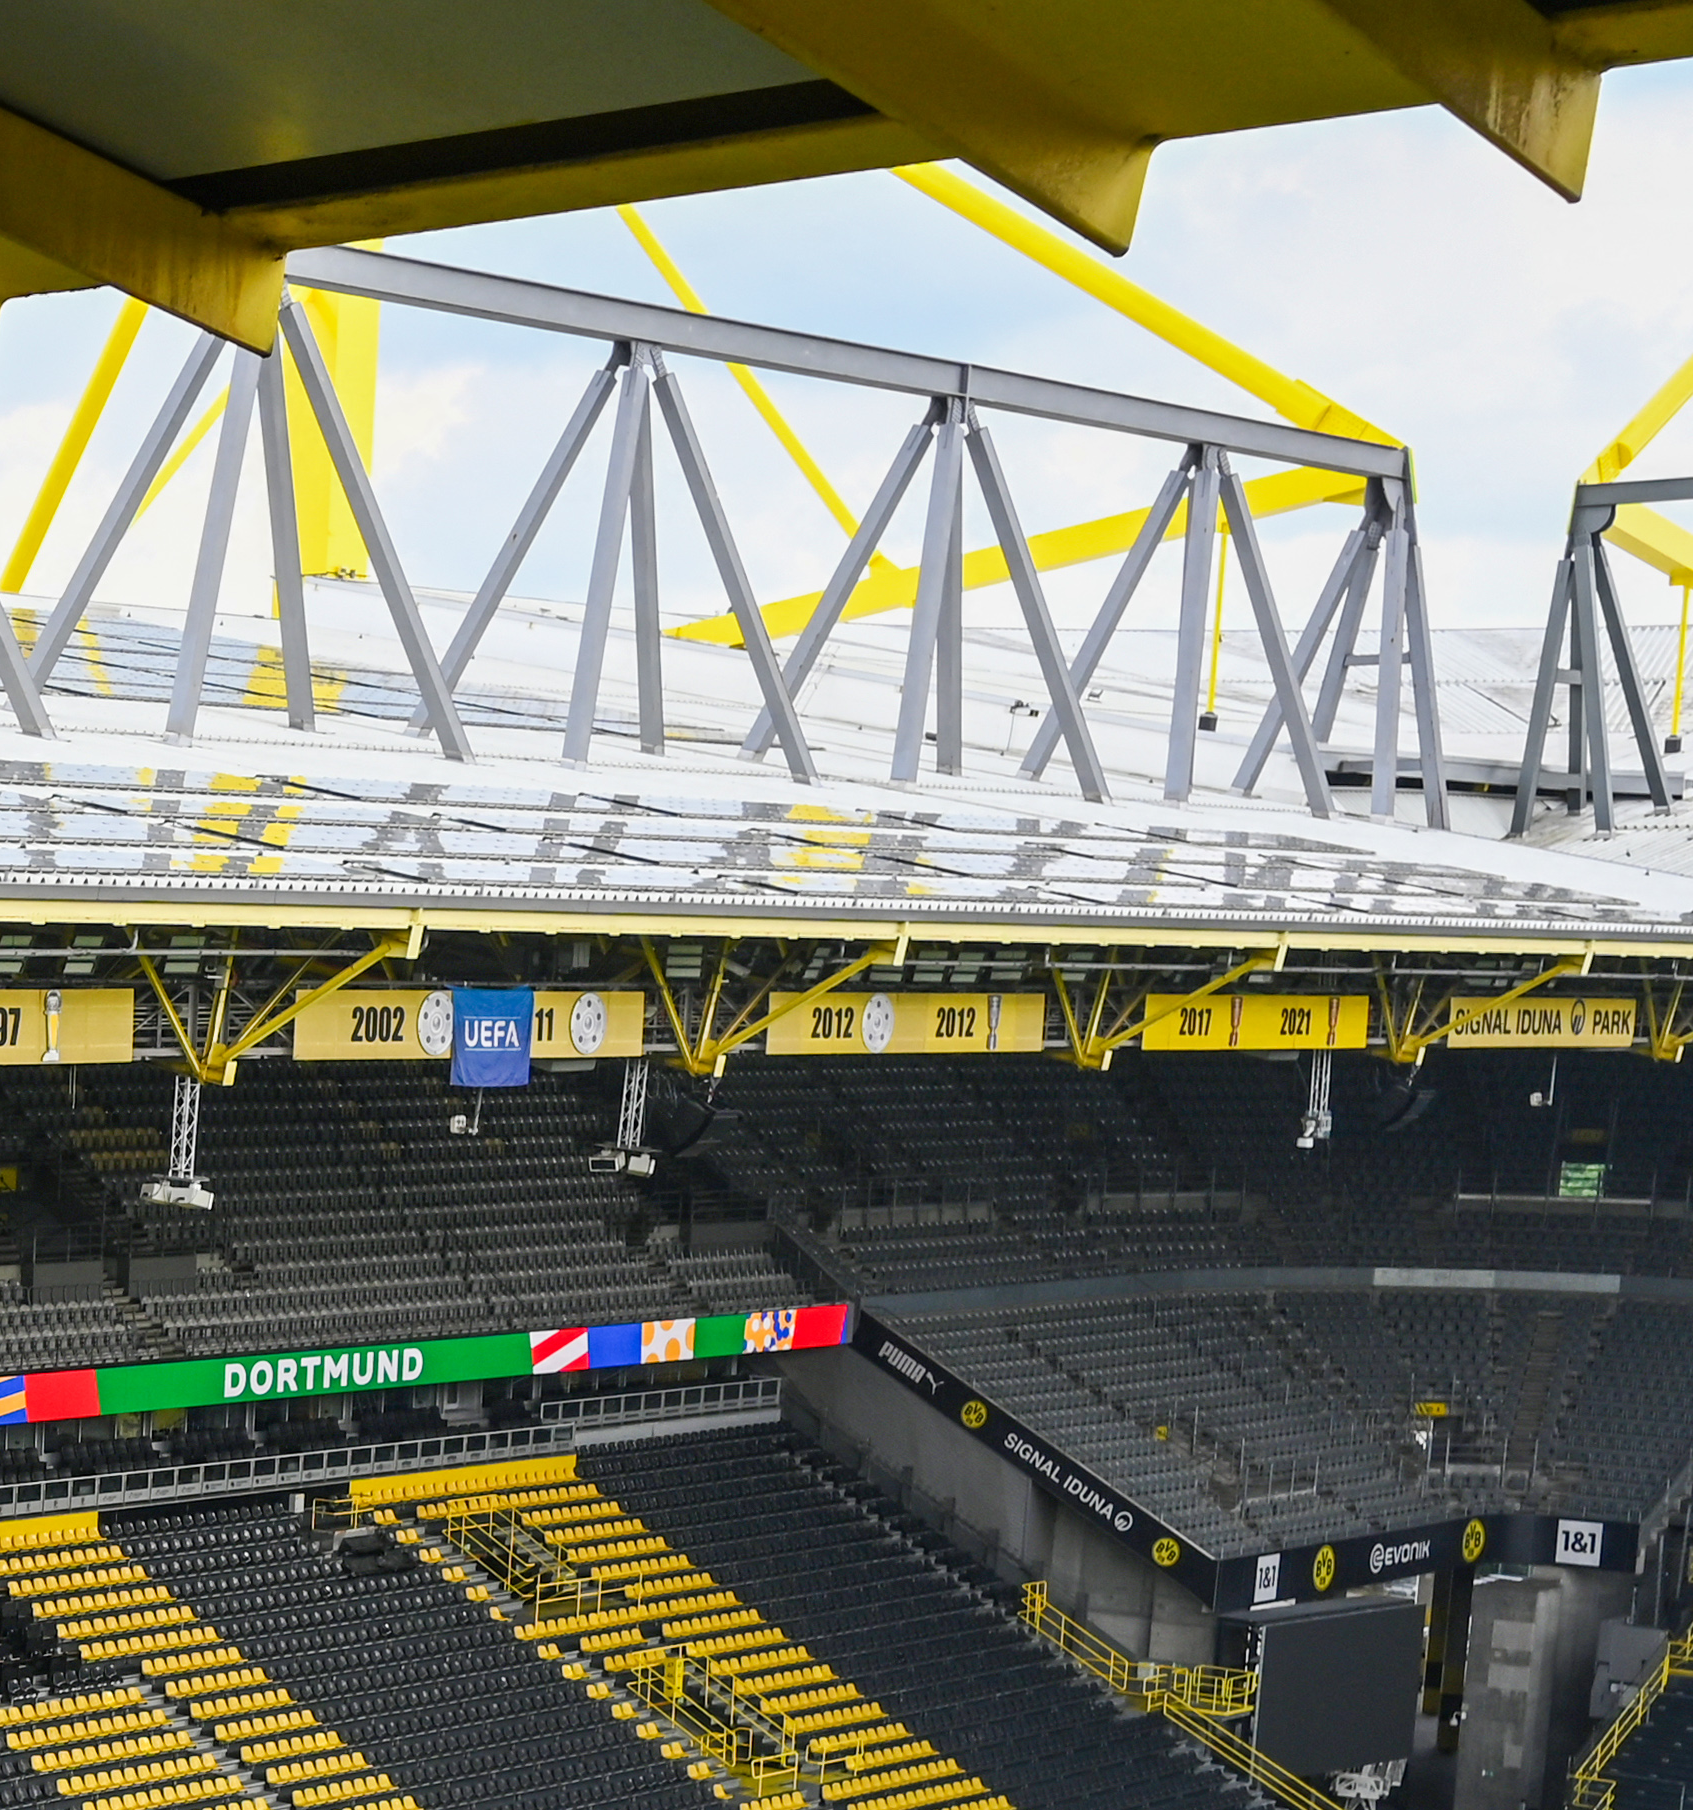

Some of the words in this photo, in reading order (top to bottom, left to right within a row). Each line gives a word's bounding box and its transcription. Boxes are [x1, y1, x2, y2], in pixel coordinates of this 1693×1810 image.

[351, 1006, 405, 1043] 2002
[465, 1020, 520, 1047] UEFA
[811, 1007, 854, 1038] 2012
[936, 1007, 975, 1038] 2012
[1179, 1008, 1212, 1036] 2017
[1280, 1008, 1311, 1035] 2021
[1454, 1008, 1511, 1035] SIGNAL
[1516, 1009, 1562, 1035] IDUNA
[1592, 1010, 1631, 1035] PARK
[224, 1348, 423, 1397] DORTMUND
[878, 1341, 927, 1384] PUMA
[964, 1403, 985, 1424] BVB
[1003, 1433, 1061, 1484] SIGNAL
[1063, 1475, 1114, 1521] IDUNA
[1464, 1525, 1481, 1549] BVB
[1562, 1530, 1597, 1554] 1&1
[1155, 1540, 1177, 1562] BVB
[1315, 1550, 1332, 1577] BVB
[1384, 1539, 1431, 1566] EVONIK
[1258, 1564, 1276, 1588] 1&1
